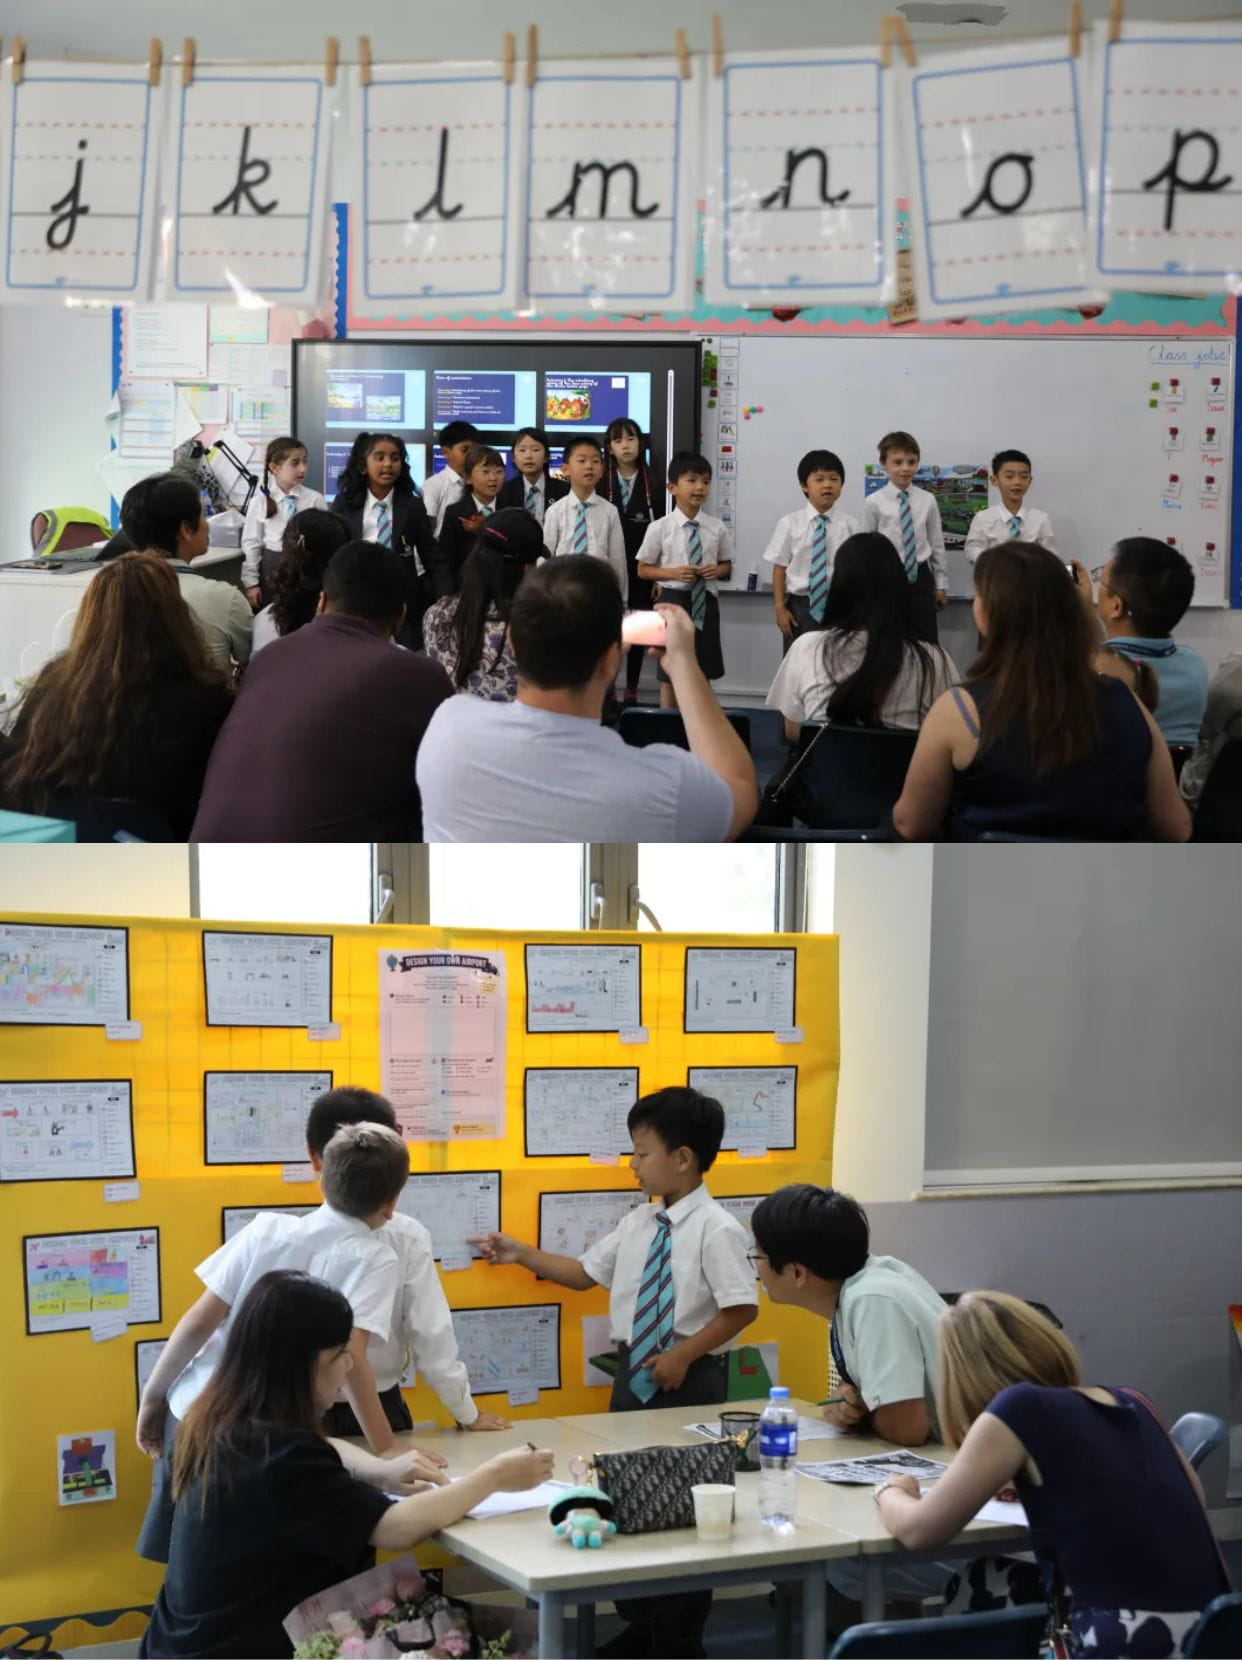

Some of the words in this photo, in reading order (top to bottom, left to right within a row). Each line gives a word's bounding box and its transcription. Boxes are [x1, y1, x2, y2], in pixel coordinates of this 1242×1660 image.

[46, 139, 90, 250] j
[213, 125, 278, 215] k
[546, 161, 660, 220] m
[761, 147, 851, 209] n
[960, 152, 1035, 219] o
[1143, 129, 1233, 231] p
[1149, 344, 1187, 360] Class
[405, 957, 428, 966] DESIGN
[429, 956, 445, 965] YOUR
[446, 956, 461, 965] OWN
[461, 957, 487, 967] AIRPORT
